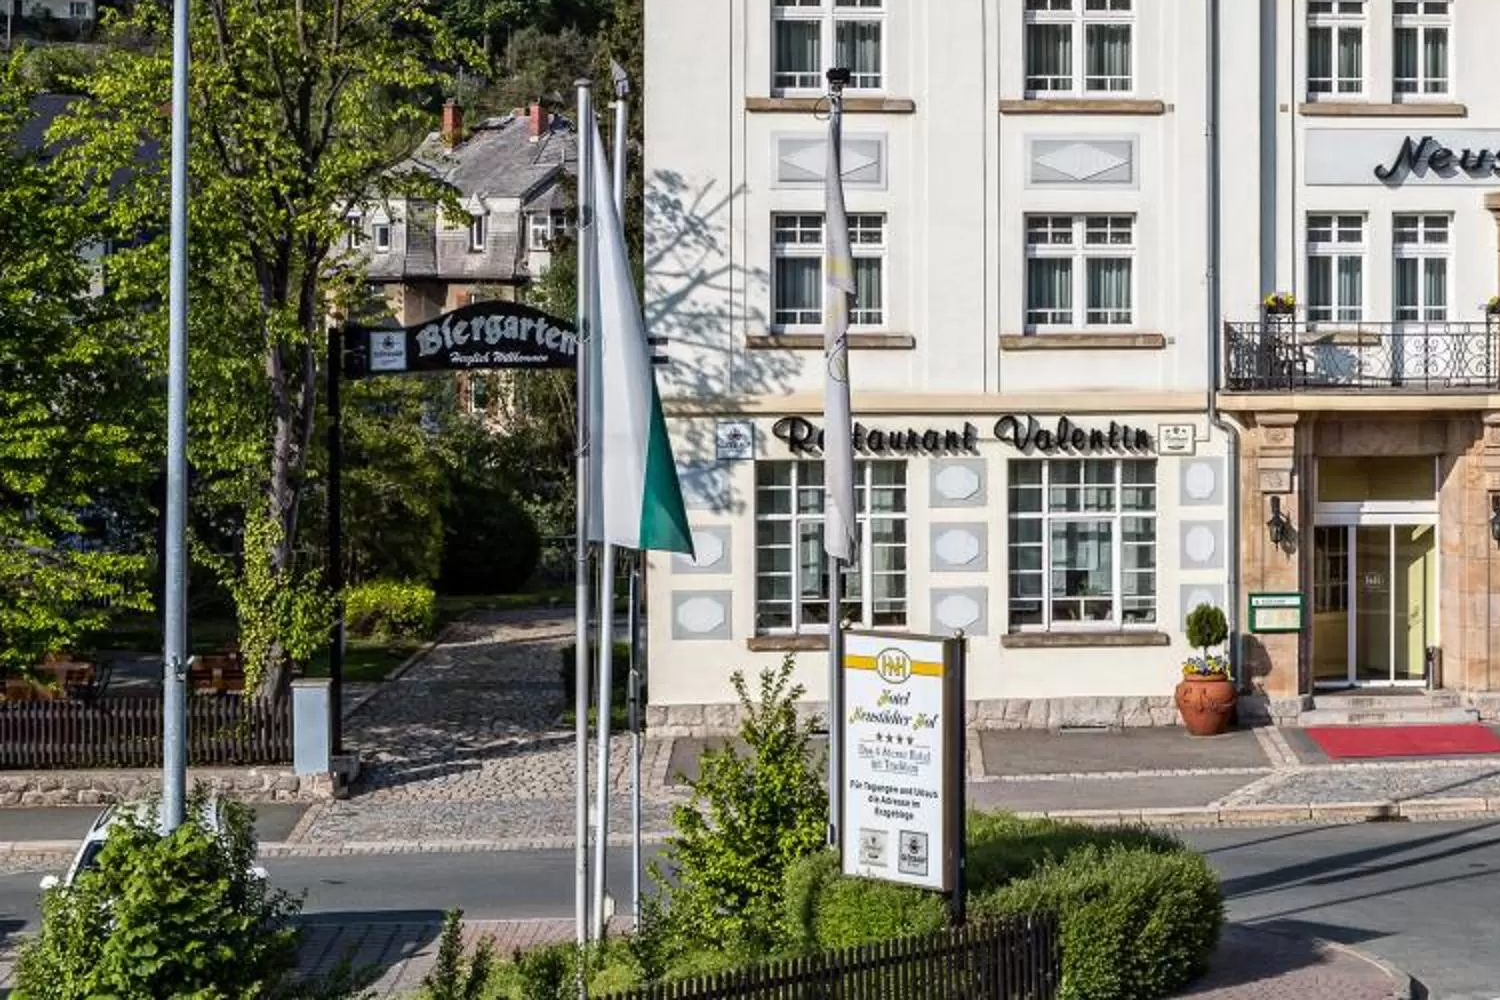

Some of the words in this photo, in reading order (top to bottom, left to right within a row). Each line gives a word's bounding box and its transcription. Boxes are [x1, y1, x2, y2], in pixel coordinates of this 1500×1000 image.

[416, 314, 577, 357] Biergarten
[772, 415, 976, 453] Rtaurant
[994, 414, 1151, 452] Valentin
